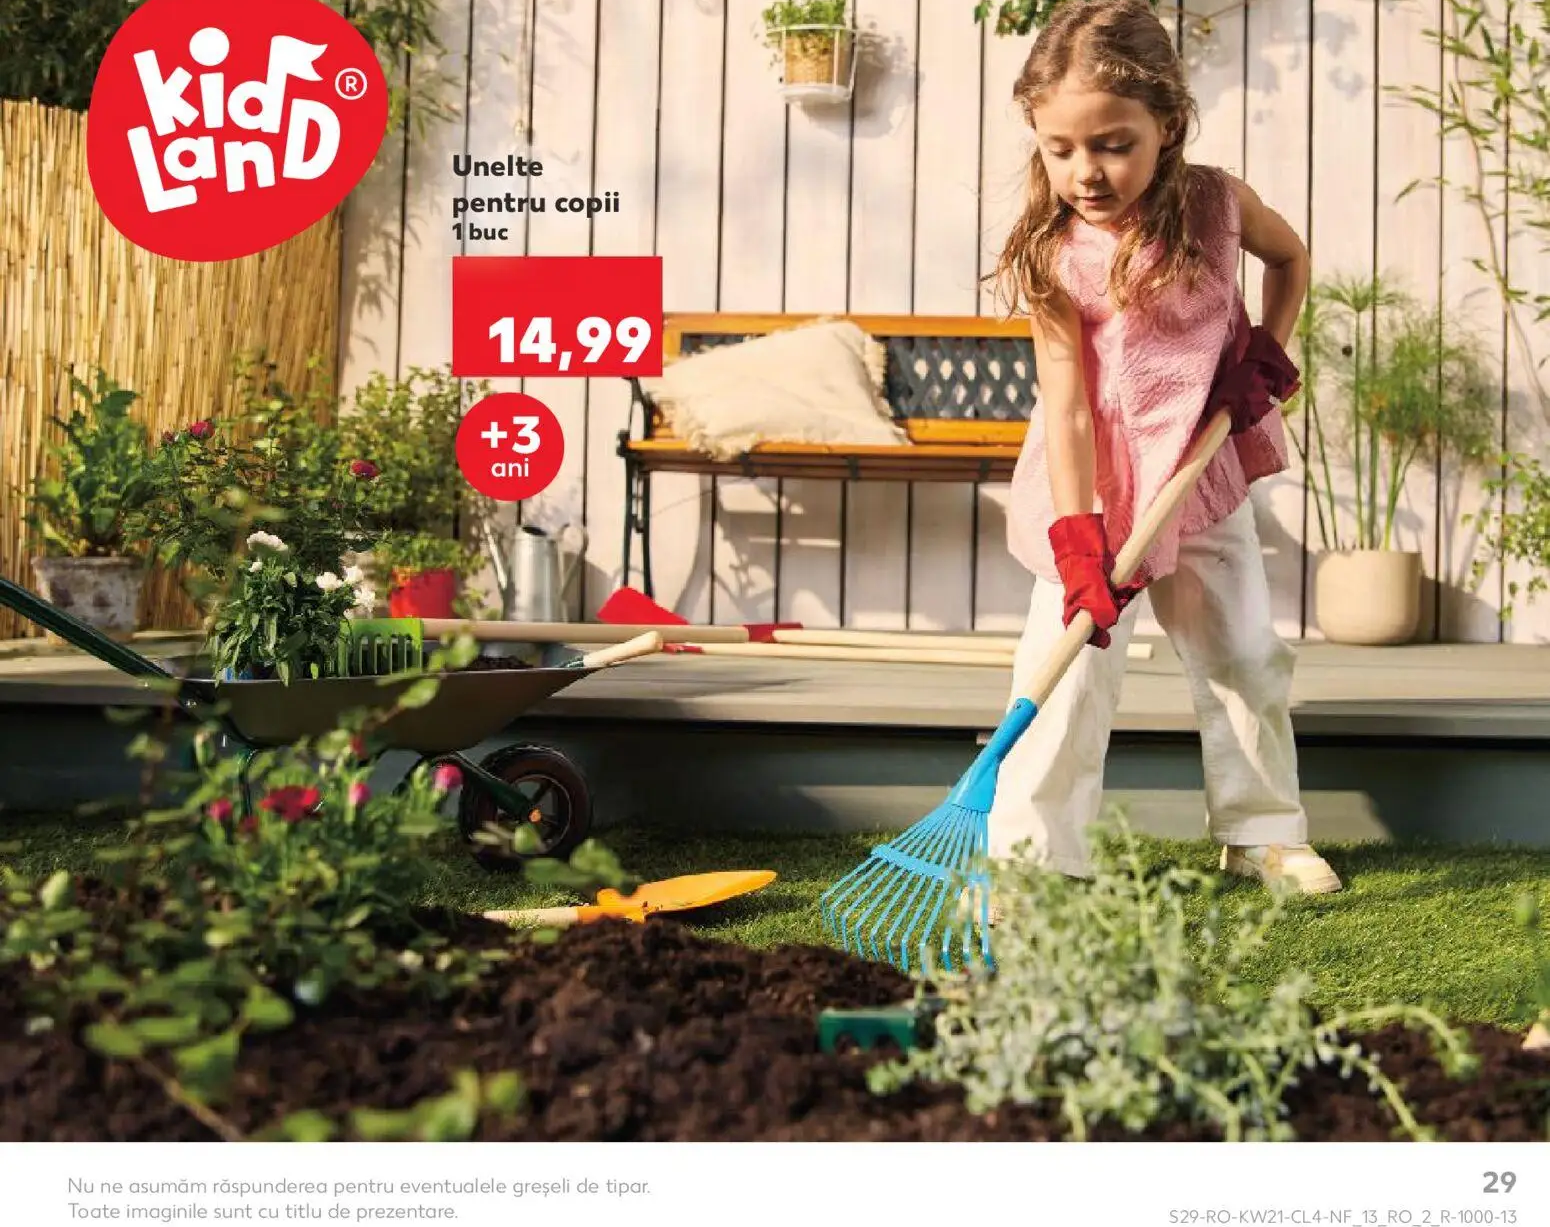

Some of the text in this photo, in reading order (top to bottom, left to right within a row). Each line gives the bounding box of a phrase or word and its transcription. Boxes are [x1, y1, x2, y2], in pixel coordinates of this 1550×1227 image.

[488, 316, 652, 371] 14,99
[68, 1178, 94, 1194] Nu
[100, 1182, 124, 1194] ne
[128, 1178, 207, 1194] asumăm
[213, 1177, 328, 1198] răspunderea
[334, 1179, 394, 1198] pentru
[399, 1177, 507, 1194] eventualele
[576, 1177, 600, 1194] de
[606, 1179, 651, 1198] tipar.
[1482, 1170, 1517, 1194] 29
[67, 1202, 459, 1223] Toate imaginile sunt cu titlu de prezentare.
[1168, 1209, 1518, 1227] S29-RO-KW21-CL4-NF_13_RO_2_R-1000-13
